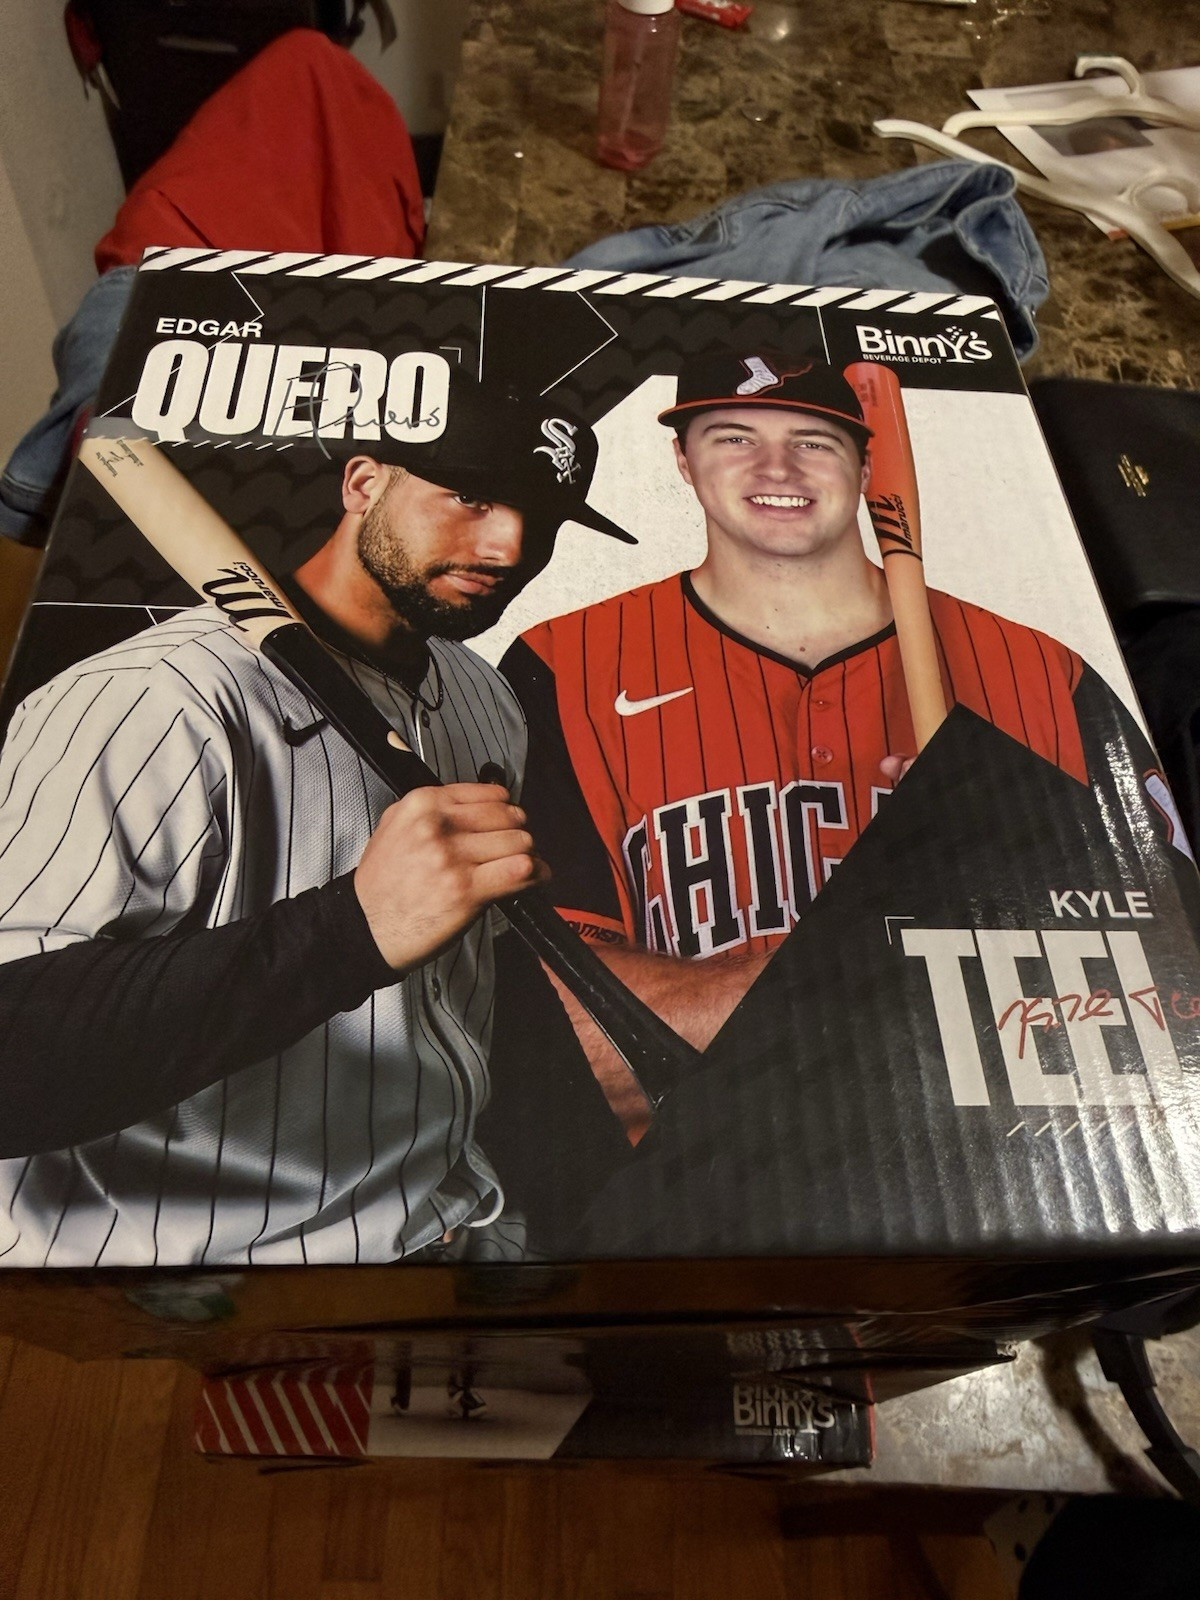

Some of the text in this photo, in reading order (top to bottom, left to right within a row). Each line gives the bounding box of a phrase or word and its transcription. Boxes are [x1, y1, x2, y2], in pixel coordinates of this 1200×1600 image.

[156, 317, 264, 338] EDGAR
[862, 353, 942, 365] BEVERAGE DEPOT
[131, 339, 451, 443] QUERO
[232, 561, 287, 609] marucci
[622, 779, 894, 961] CHIC
[1050, 890, 1154, 918] KYLE
